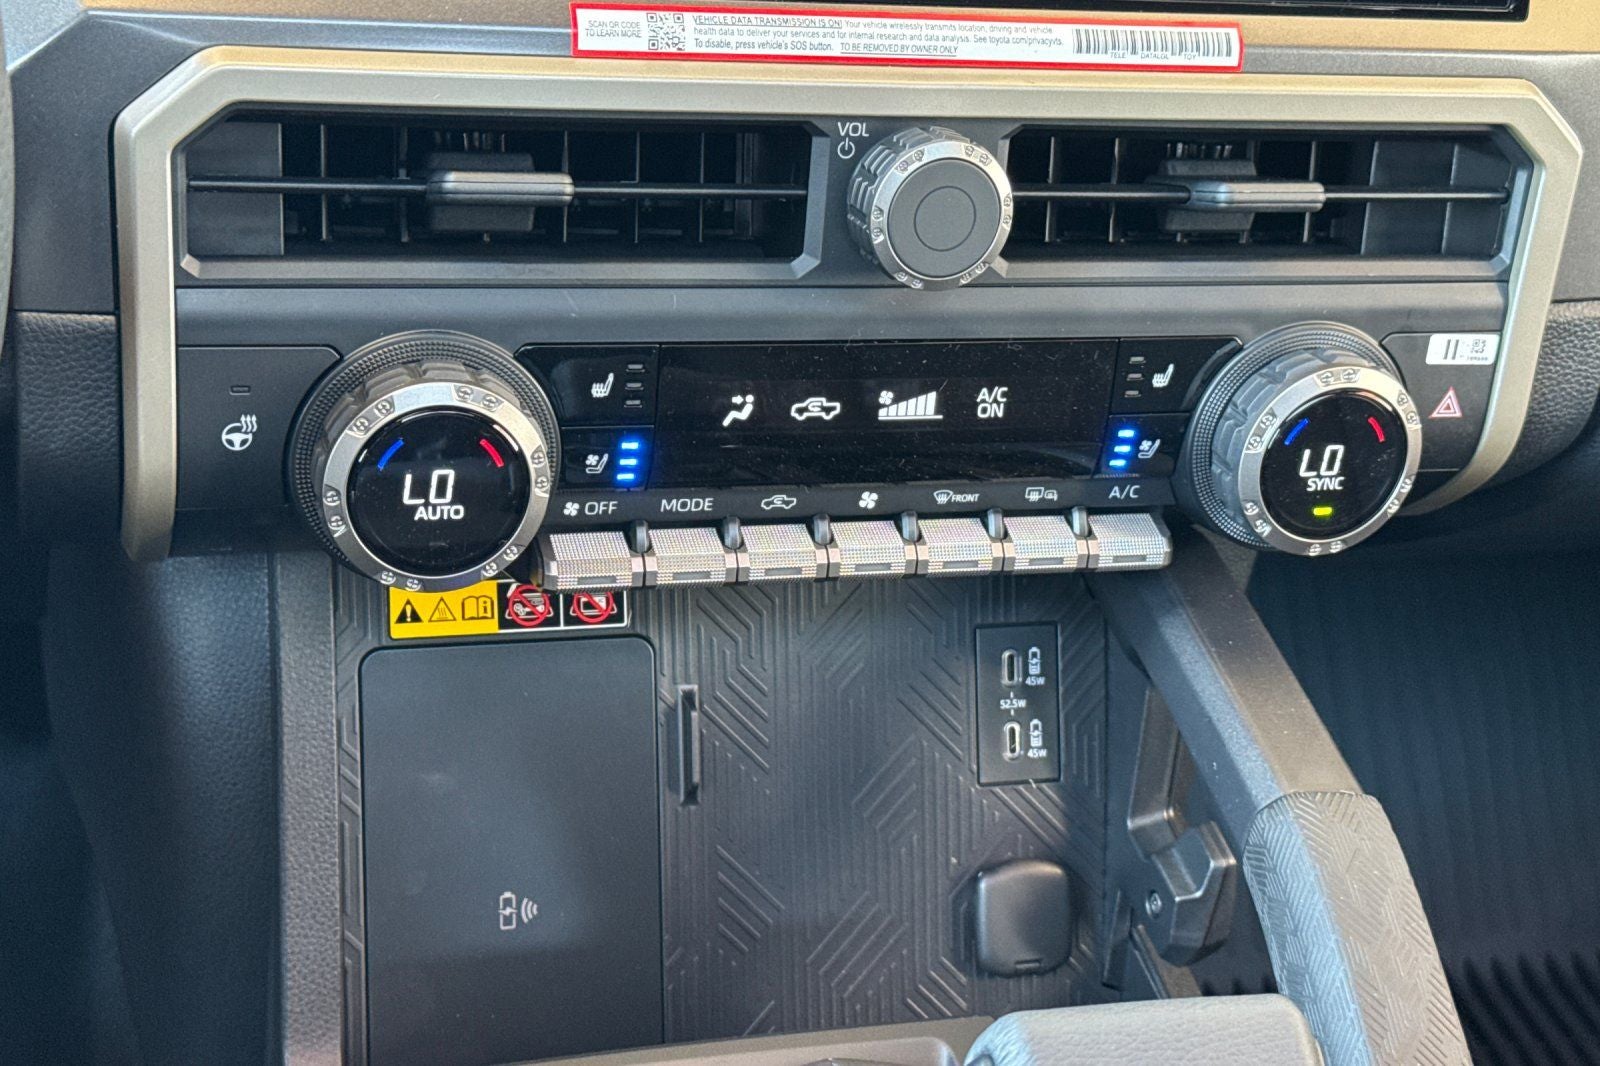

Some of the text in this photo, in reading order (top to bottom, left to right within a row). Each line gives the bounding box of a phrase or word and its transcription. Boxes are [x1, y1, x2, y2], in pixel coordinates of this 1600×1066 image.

[588, 20, 641, 29] SCAN QR CODE
[692, 15, 729, 25] VEHICLE
[731, 16, 753, 25] DATA
[754, 16, 817, 27] TRANSMISSION
[818, 19, 826, 27] IS
[845, 20, 861, 28] Your
[863, 20, 888, 29] vehicle
[890, 22, 923, 32] wirelessly
[925, 22, 957, 32] transmits
[958, 24, 988, 33] location,
[989, 24, 1012, 34] driving
[1014, 26, 1027, 34] and
[1030, 26, 1053, 34] vehicle
[585, 28, 642, 38] TO LEARN MORE
[693, 27, 716, 36] health
[718, 28, 734, 36] data
[736, 28, 744, 36] to
[746, 28, 771, 37] deliver
[772, 30, 788, 40] your
[790, 30, 820, 39] services
[822, 30, 836, 38] and
[837, 30, 847, 39] for
[849, 31, 875, 40] internal
[876, 32, 908, 40] research
[910, 32, 924, 41] and
[925, 33, 940, 42] data
[974, 34, 988, 44] See
[694, 38, 834, 52] To disable, press vehicle's SOS button.
[840, 42, 958, 54] TO BE REMOVED BY OWNER ONLY
[837, 122, 870, 138] VOL
[976, 386, 1008, 403] A/C
[977, 403, 1004, 418] ON
[1306, 477, 1345, 492] SYNC
[951, 493, 980, 503] FRONT
[1108, 484, 1141, 500] A/C
[584, 500, 618, 516] OFF
[660, 498, 714, 512] MODE
[414, 504, 465, 521] AUTO
[1025, 676, 1046, 686] 45W
[1000, 699, 1027, 709] 52.5W
[1027, 748, 1048, 758] 45W
